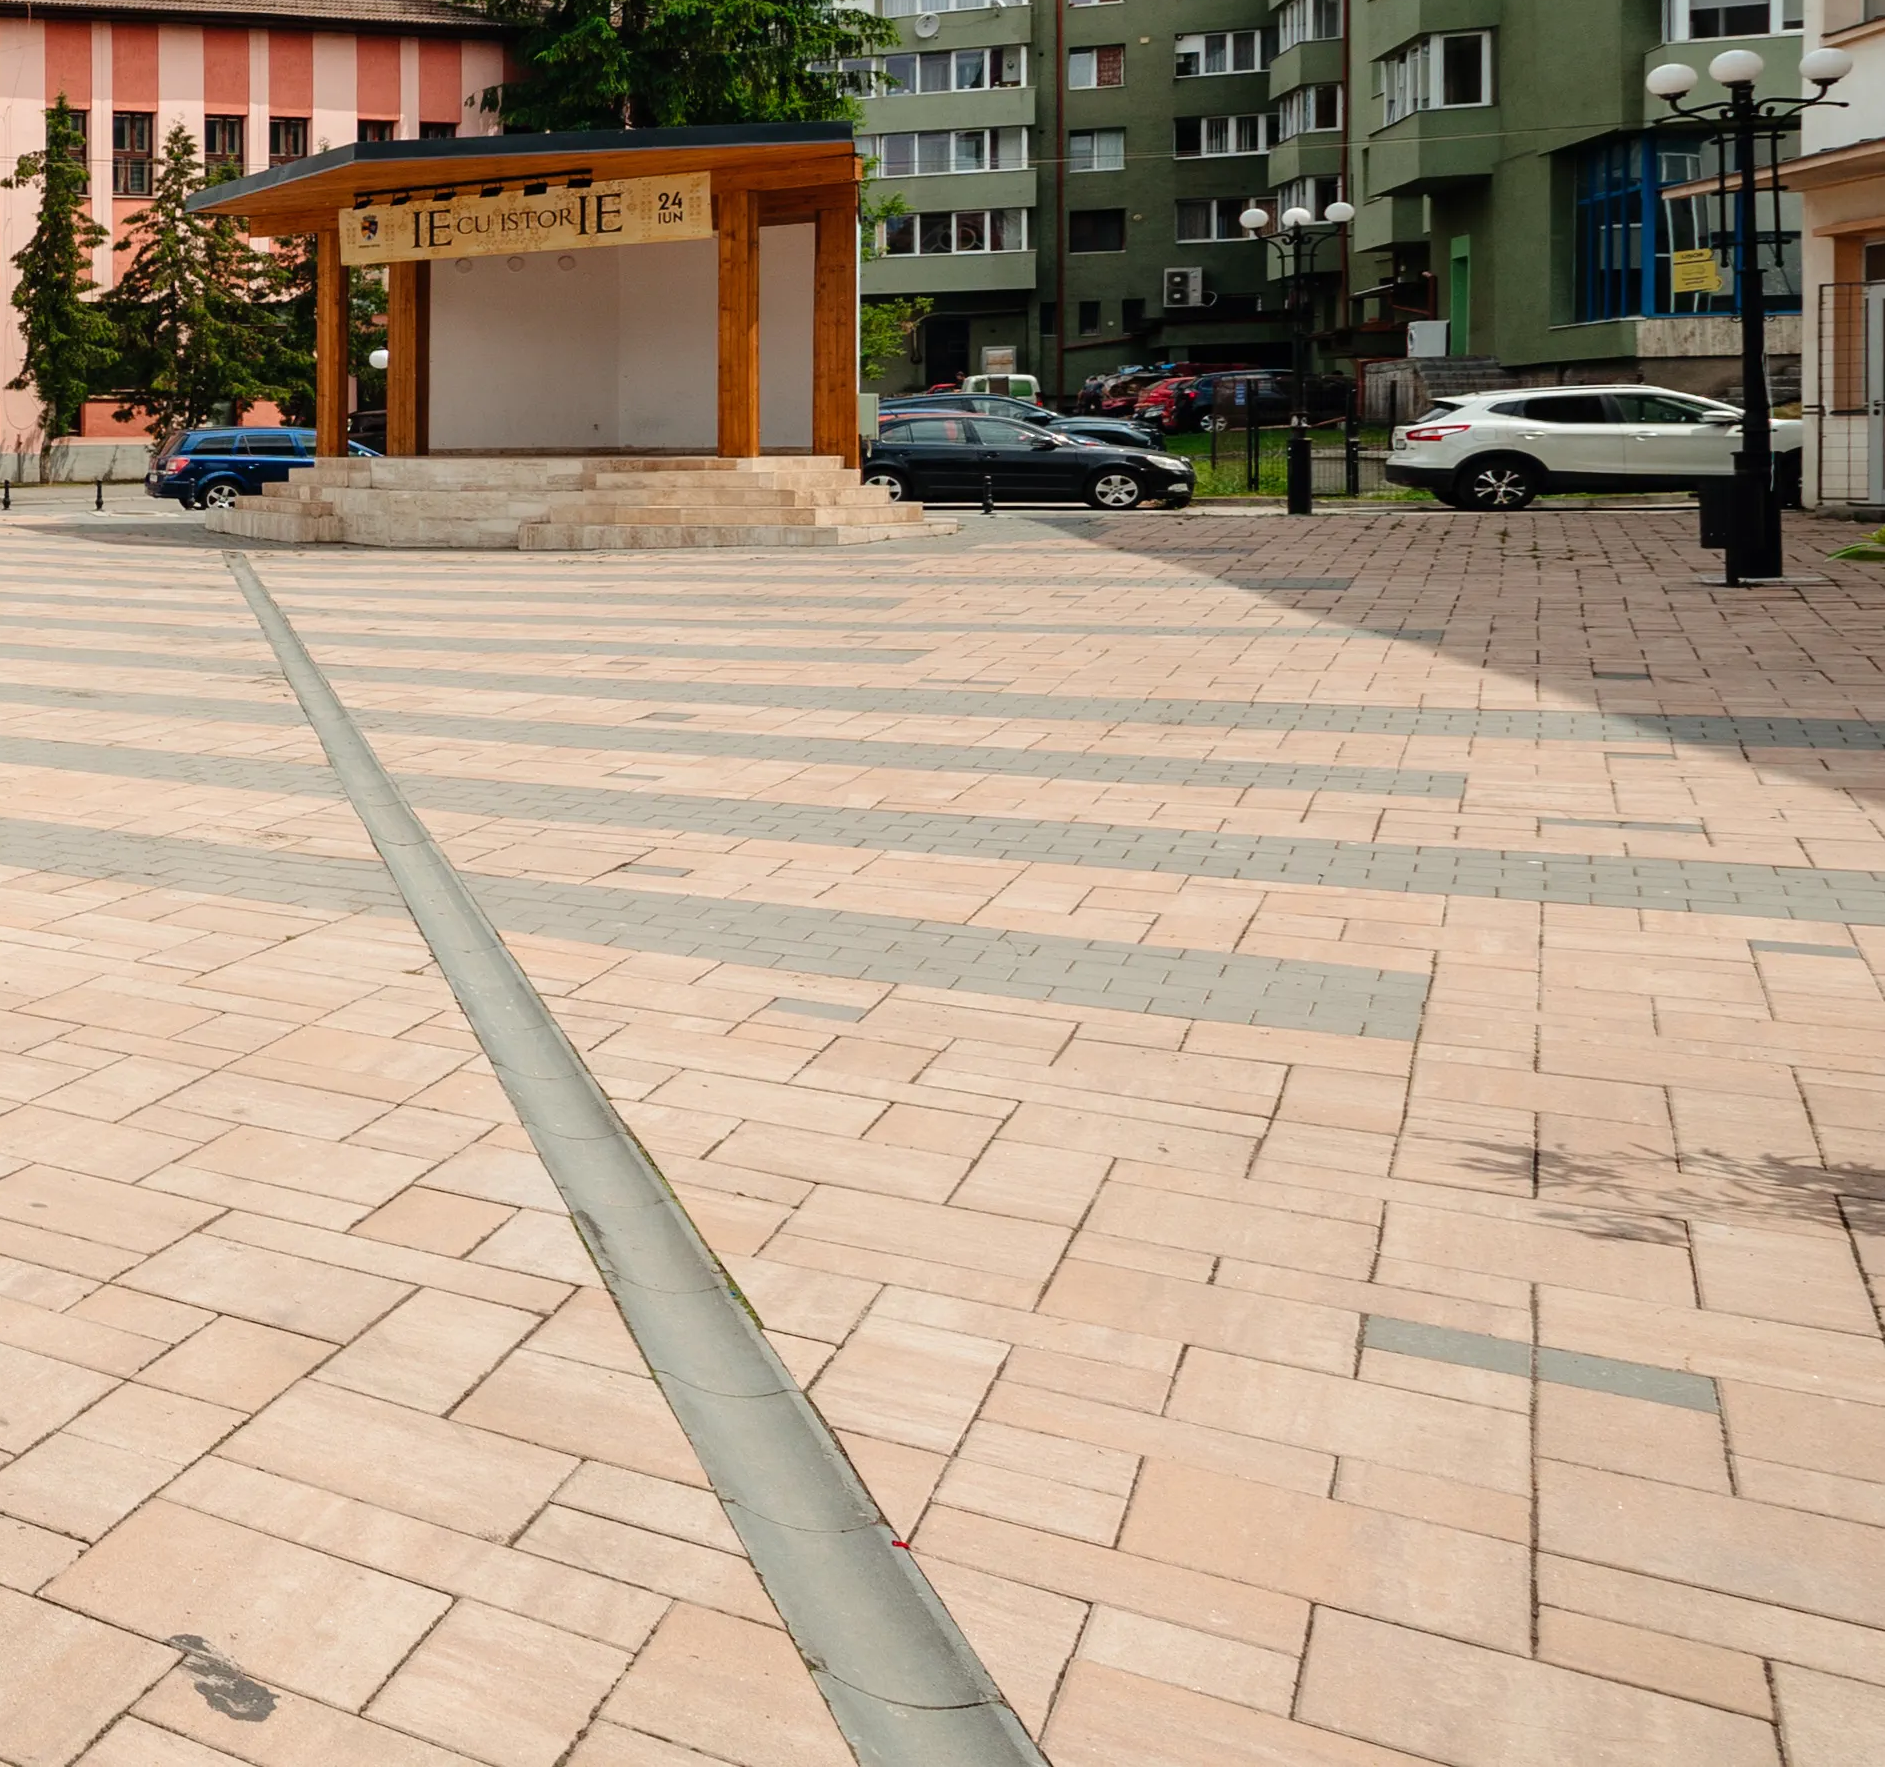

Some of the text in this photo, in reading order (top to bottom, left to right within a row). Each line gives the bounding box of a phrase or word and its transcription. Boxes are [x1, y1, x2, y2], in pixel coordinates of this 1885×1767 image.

[658, 192, 683, 211] 24
[658, 211, 684, 225] IUN
[411, 209, 452, 248] IE
[456, 214, 491, 234] CU
